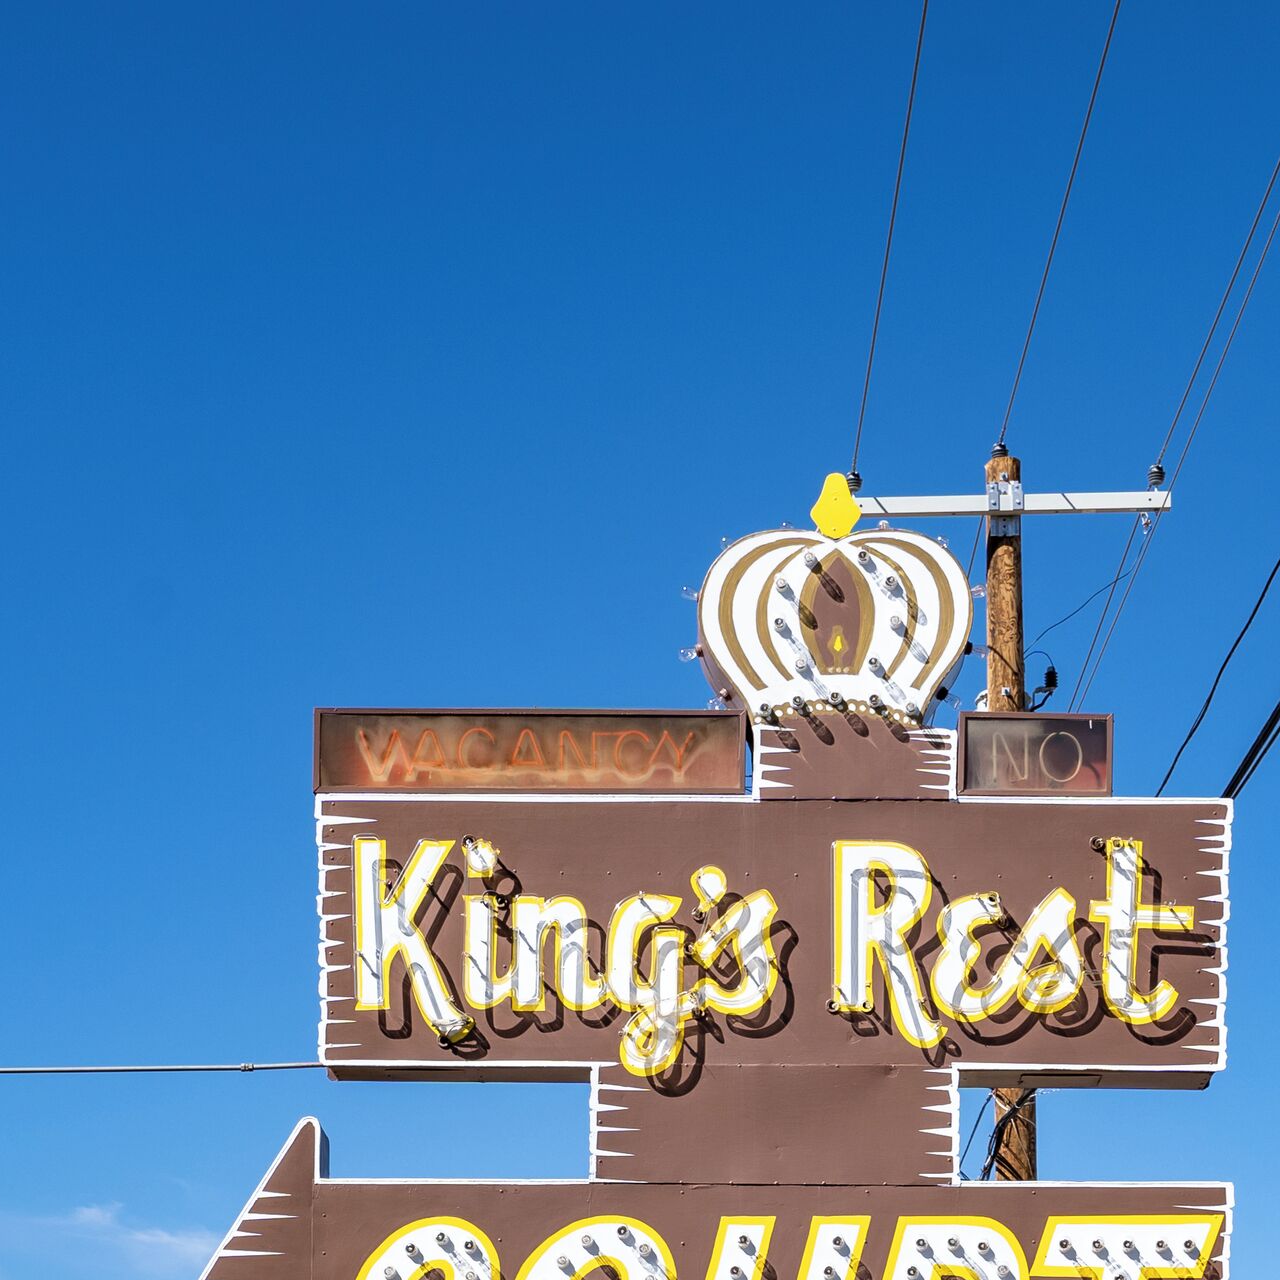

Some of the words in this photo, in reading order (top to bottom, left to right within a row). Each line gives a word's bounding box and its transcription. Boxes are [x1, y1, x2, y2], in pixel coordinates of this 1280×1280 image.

[357, 726, 697, 781] VACANCY
[992, 730, 1083, 783] NO
[351, 835, 778, 1077] King's
[831, 836, 1195, 1050] Rest
